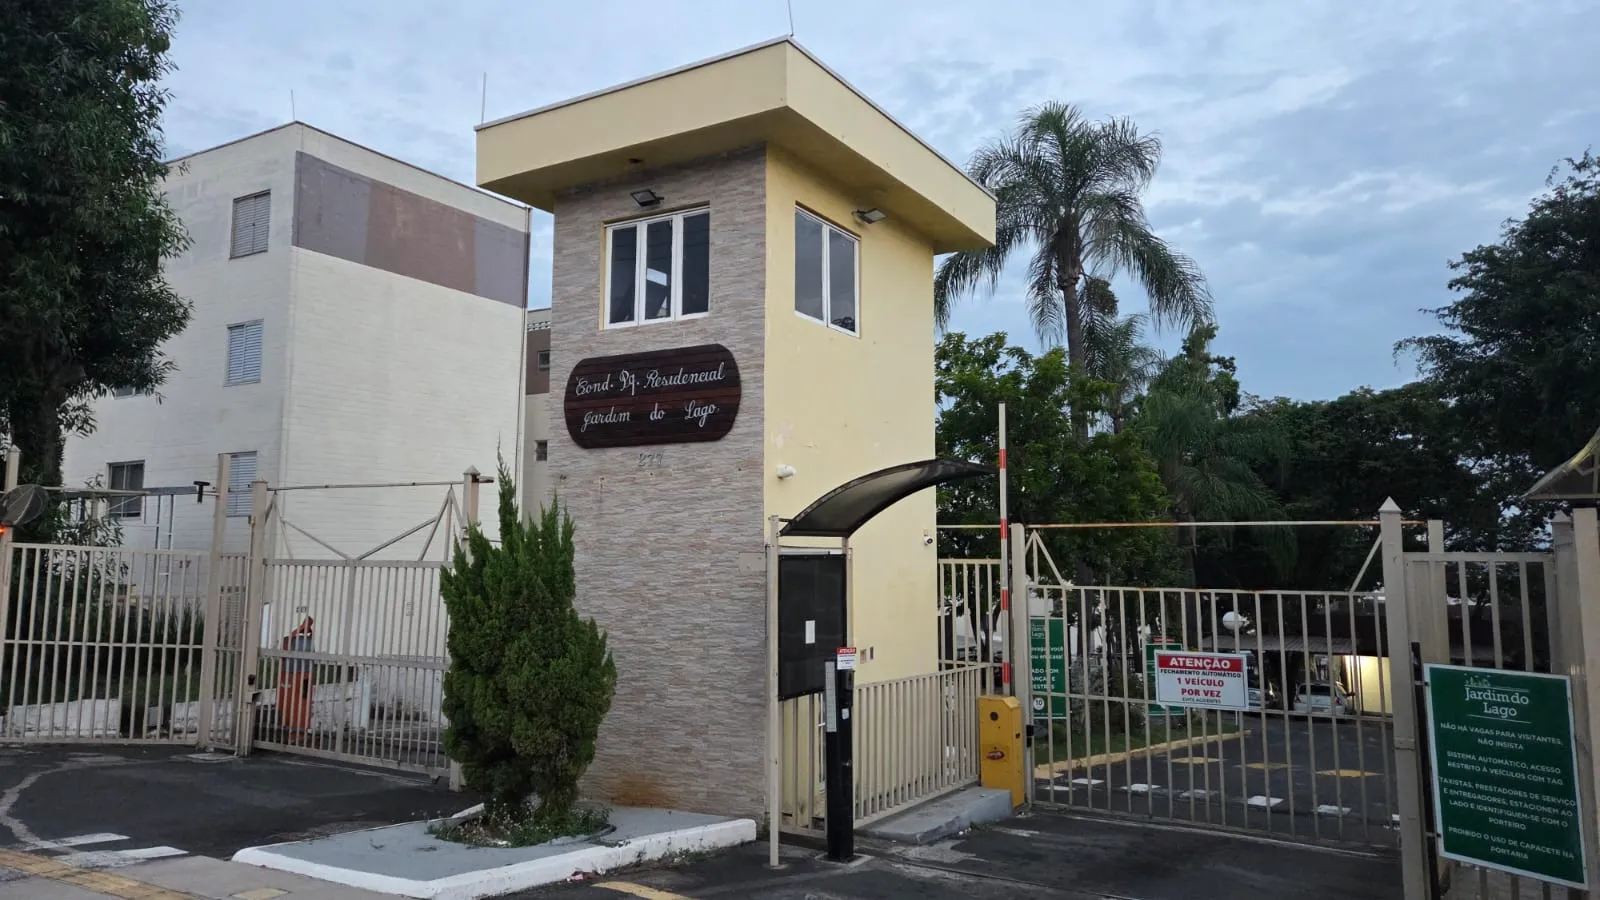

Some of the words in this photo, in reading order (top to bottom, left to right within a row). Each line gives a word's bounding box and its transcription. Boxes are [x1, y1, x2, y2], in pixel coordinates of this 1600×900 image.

[643, 362, 725, 389] Residencial
[581, 406, 631, 432] Jardim
[650, 403, 665, 421] do
[1169, 656, 1231, 670] ATENÇÃO
[1202, 670, 1242, 679] AUTOMÁTICO
[1177, 677, 1182, 685] 1
[1184, 677, 1224, 687] VEÍCULO
[1181, 688, 1201, 697] POR
[1203, 689, 1221, 698] VEZ
[1465, 687, 1511, 703] Jardim
[1510, 692, 1529, 705] do
[1482, 702, 1518, 718] Lago
[1469, 726, 1494, 735] VAGAS
[1495, 729, 1515, 738] PARA
[1495, 740, 1524, 750] INSISTA
